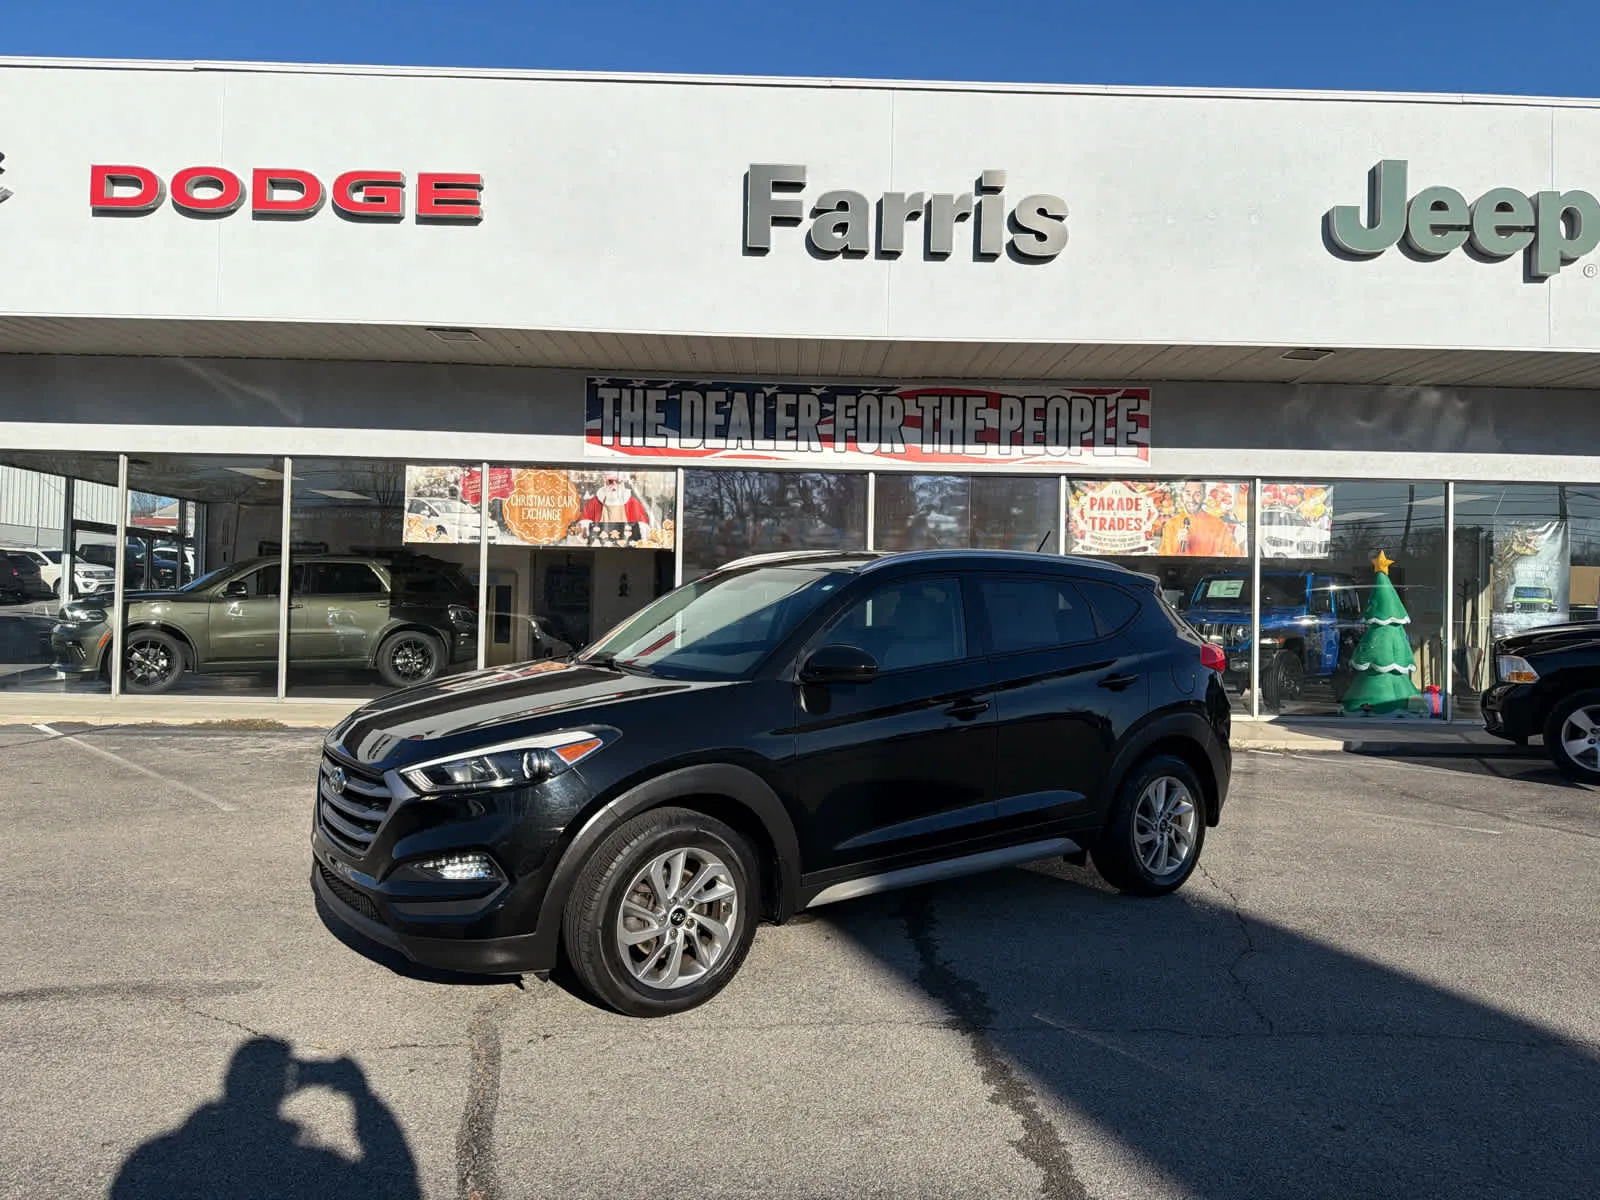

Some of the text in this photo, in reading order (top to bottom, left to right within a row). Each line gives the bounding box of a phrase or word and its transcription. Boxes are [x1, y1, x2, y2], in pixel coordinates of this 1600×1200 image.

[90, 165, 483, 224] DODGE
[744, 163, 1070, 262] Farris
[1324, 159, 1600, 281] Jeep
[597, 387, 1141, 457] THE DEALER FOR THE PEOPLE
[510, 494, 574, 508] CHRISTMAS CAR
[521, 507, 563, 521] EXCHANGE
[1089, 496, 1143, 512] PARADE
[1088, 516, 1143, 532] TRADES
